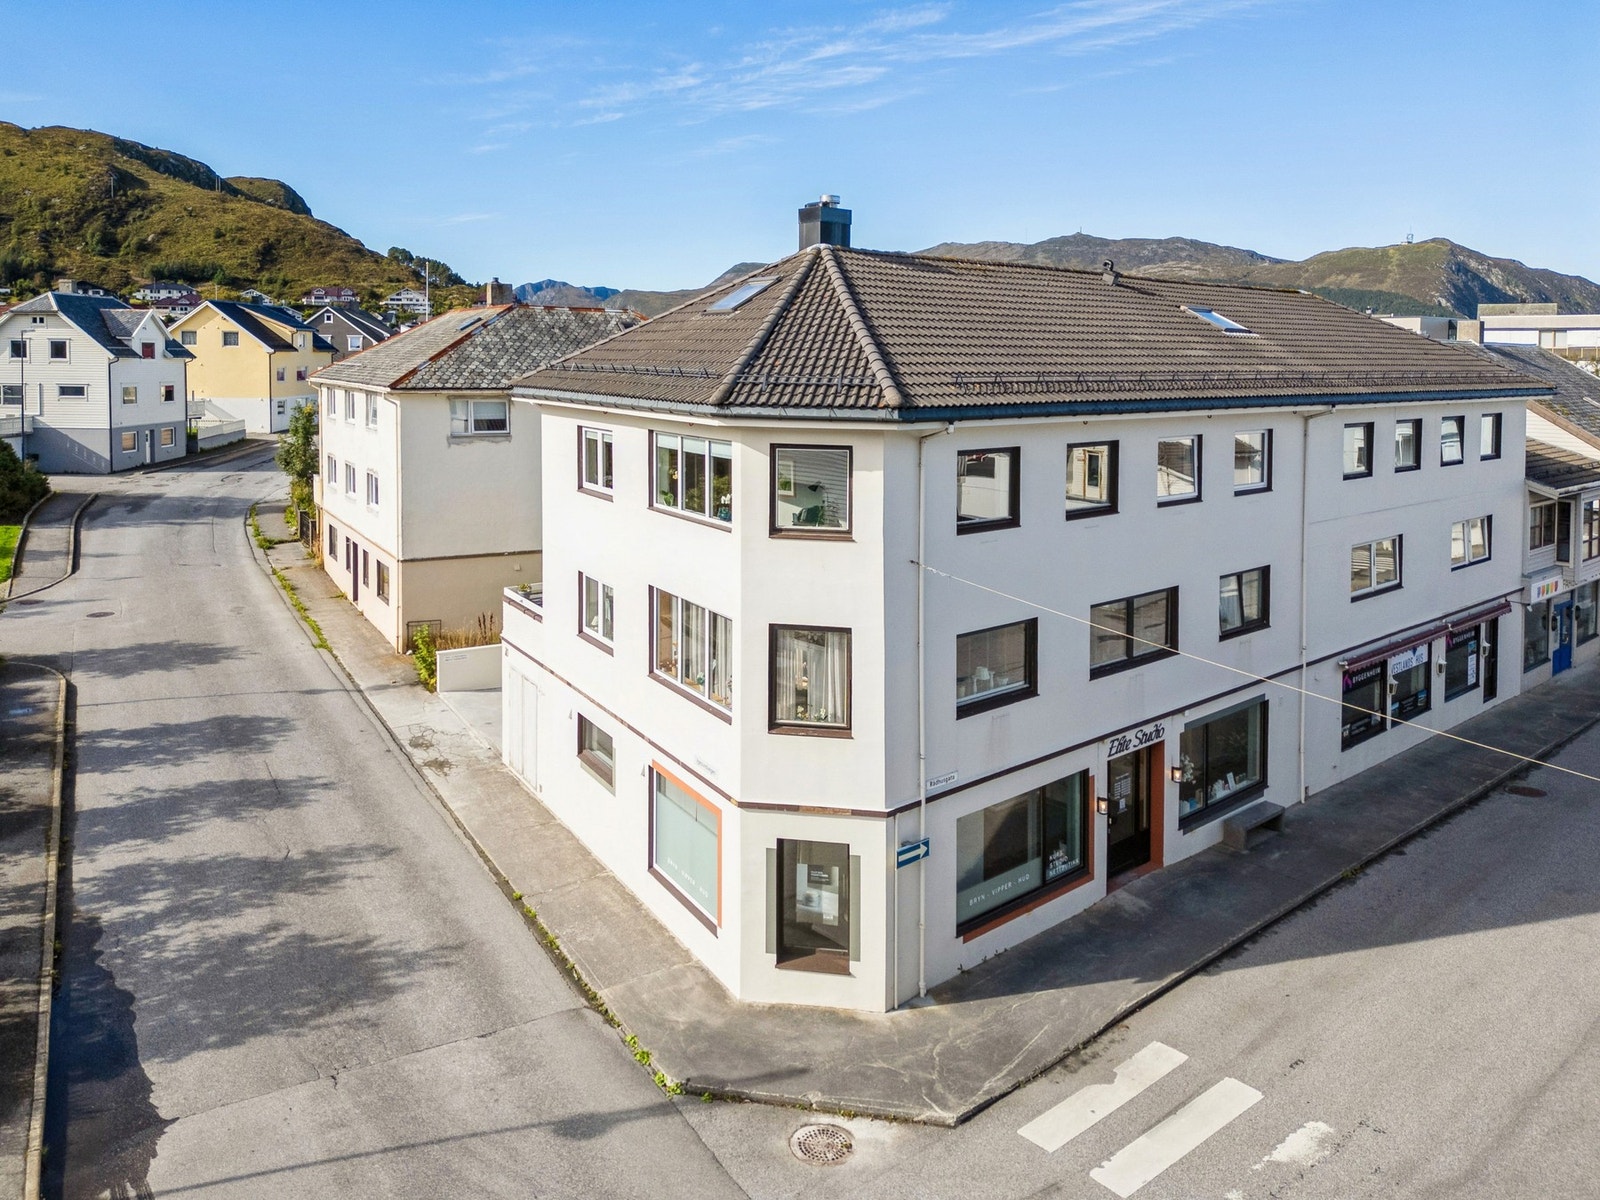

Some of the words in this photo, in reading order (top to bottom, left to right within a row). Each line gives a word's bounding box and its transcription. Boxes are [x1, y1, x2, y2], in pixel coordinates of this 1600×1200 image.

[1107, 735, 1132, 758] Elite
[1132, 722, 1165, 748] Studio
[969, 894, 985, 906] BRYN
[991, 881, 1013, 896] VIPPER
